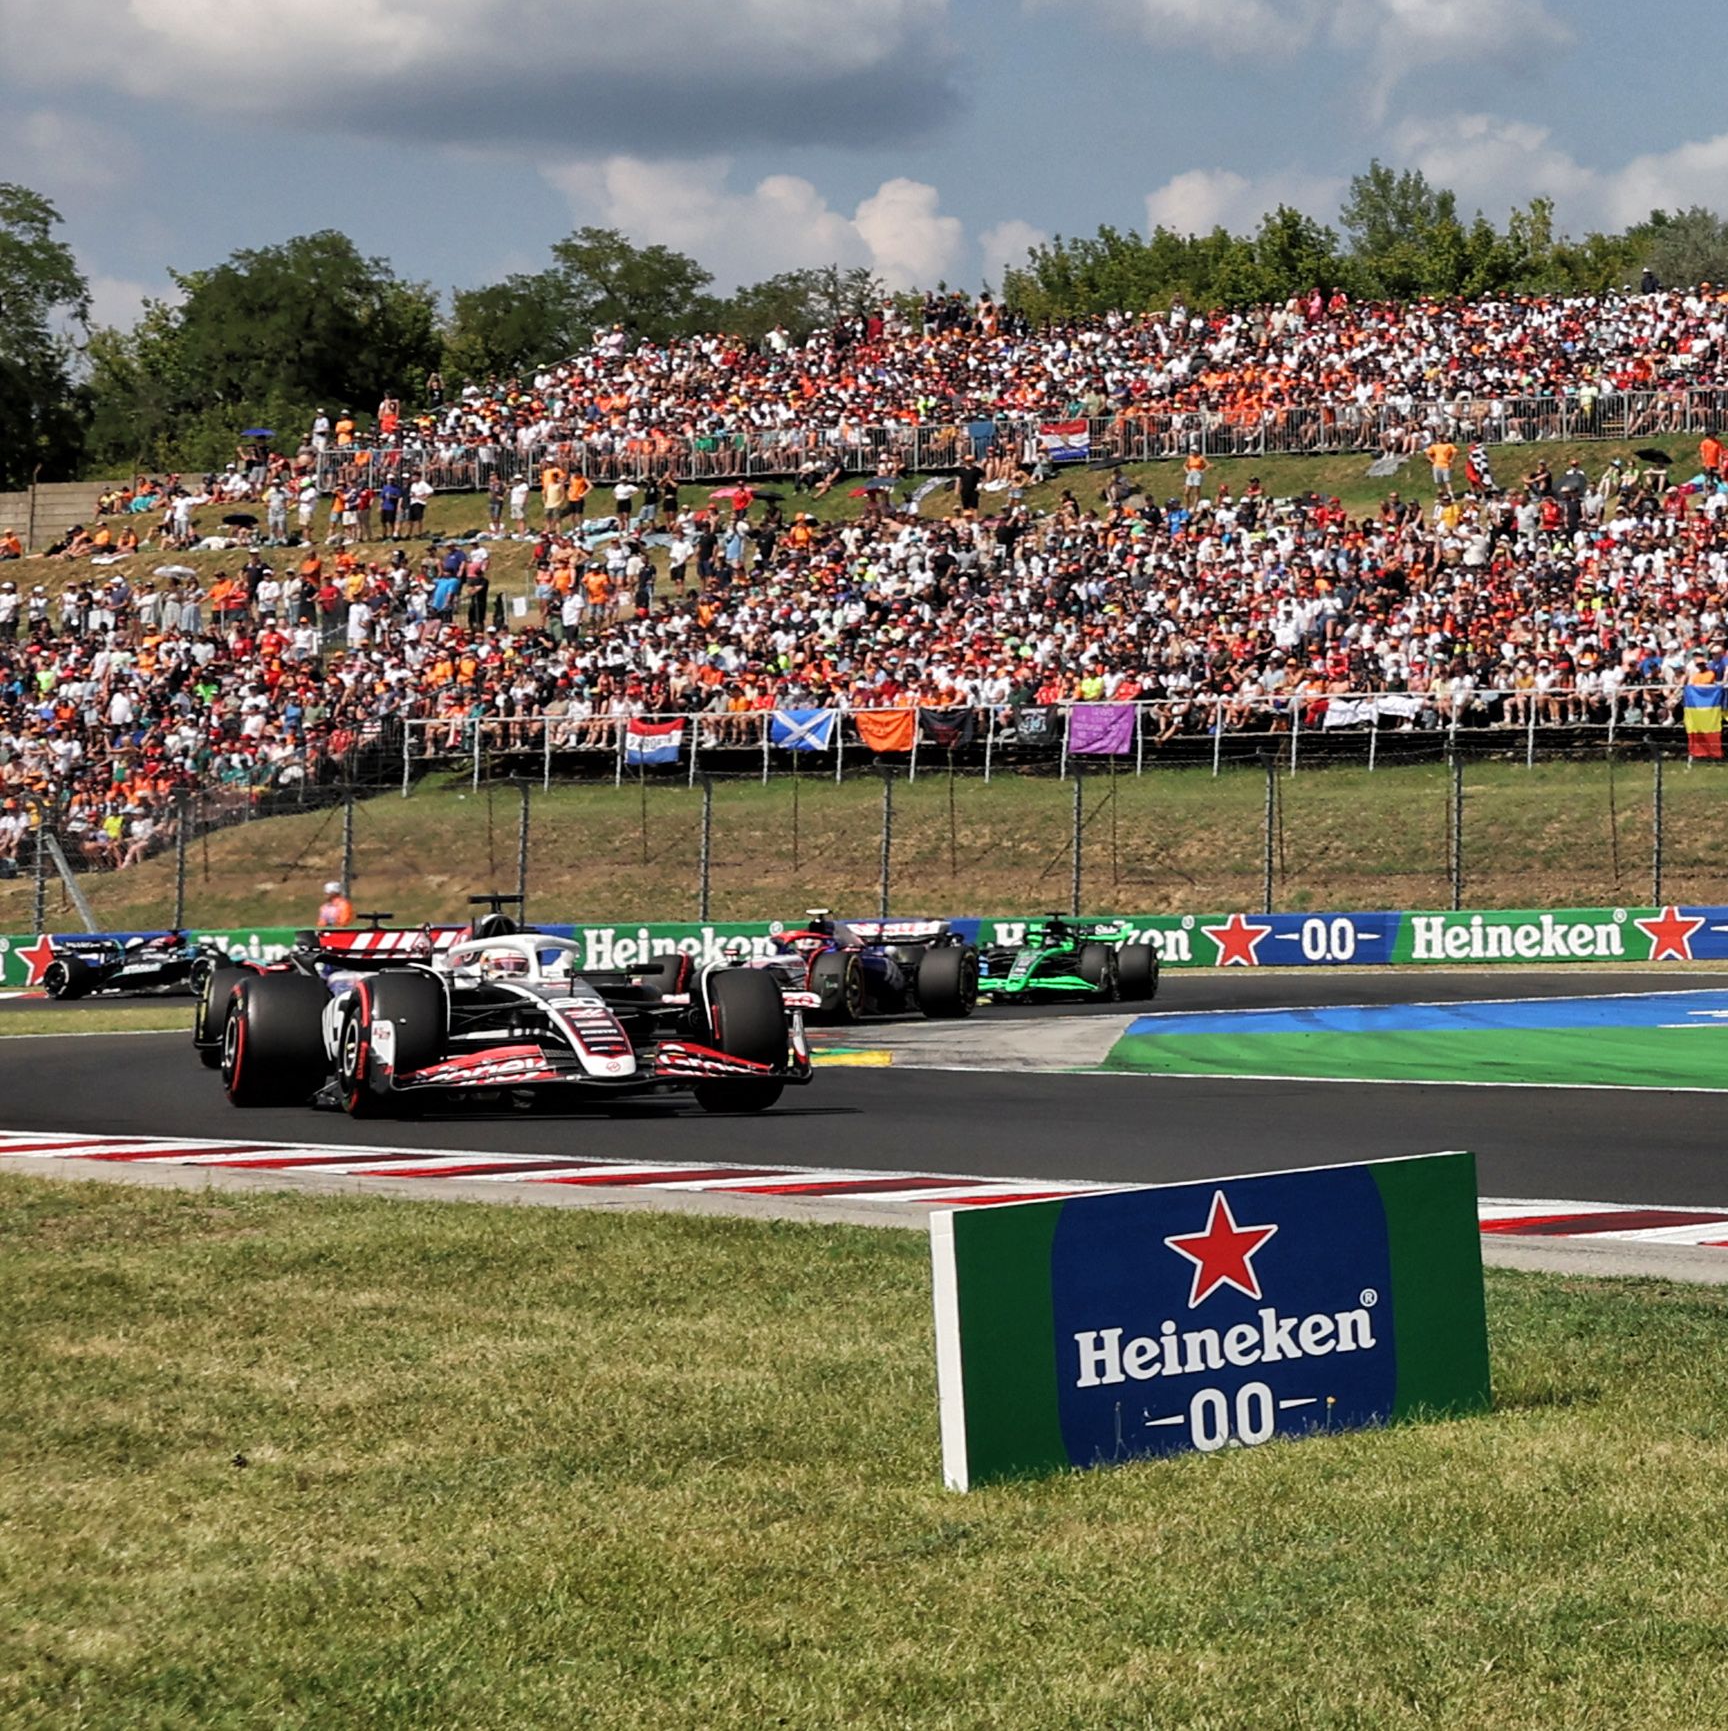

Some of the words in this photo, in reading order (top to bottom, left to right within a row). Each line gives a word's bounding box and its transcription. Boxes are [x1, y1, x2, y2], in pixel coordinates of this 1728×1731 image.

[1302, 918, 1355, 960] 0.0
[1411, 915, 1625, 959] Heineken
[1074, 1307, 1377, 1388] Heineken
[1190, 1381, 1275, 1452] 0.0
